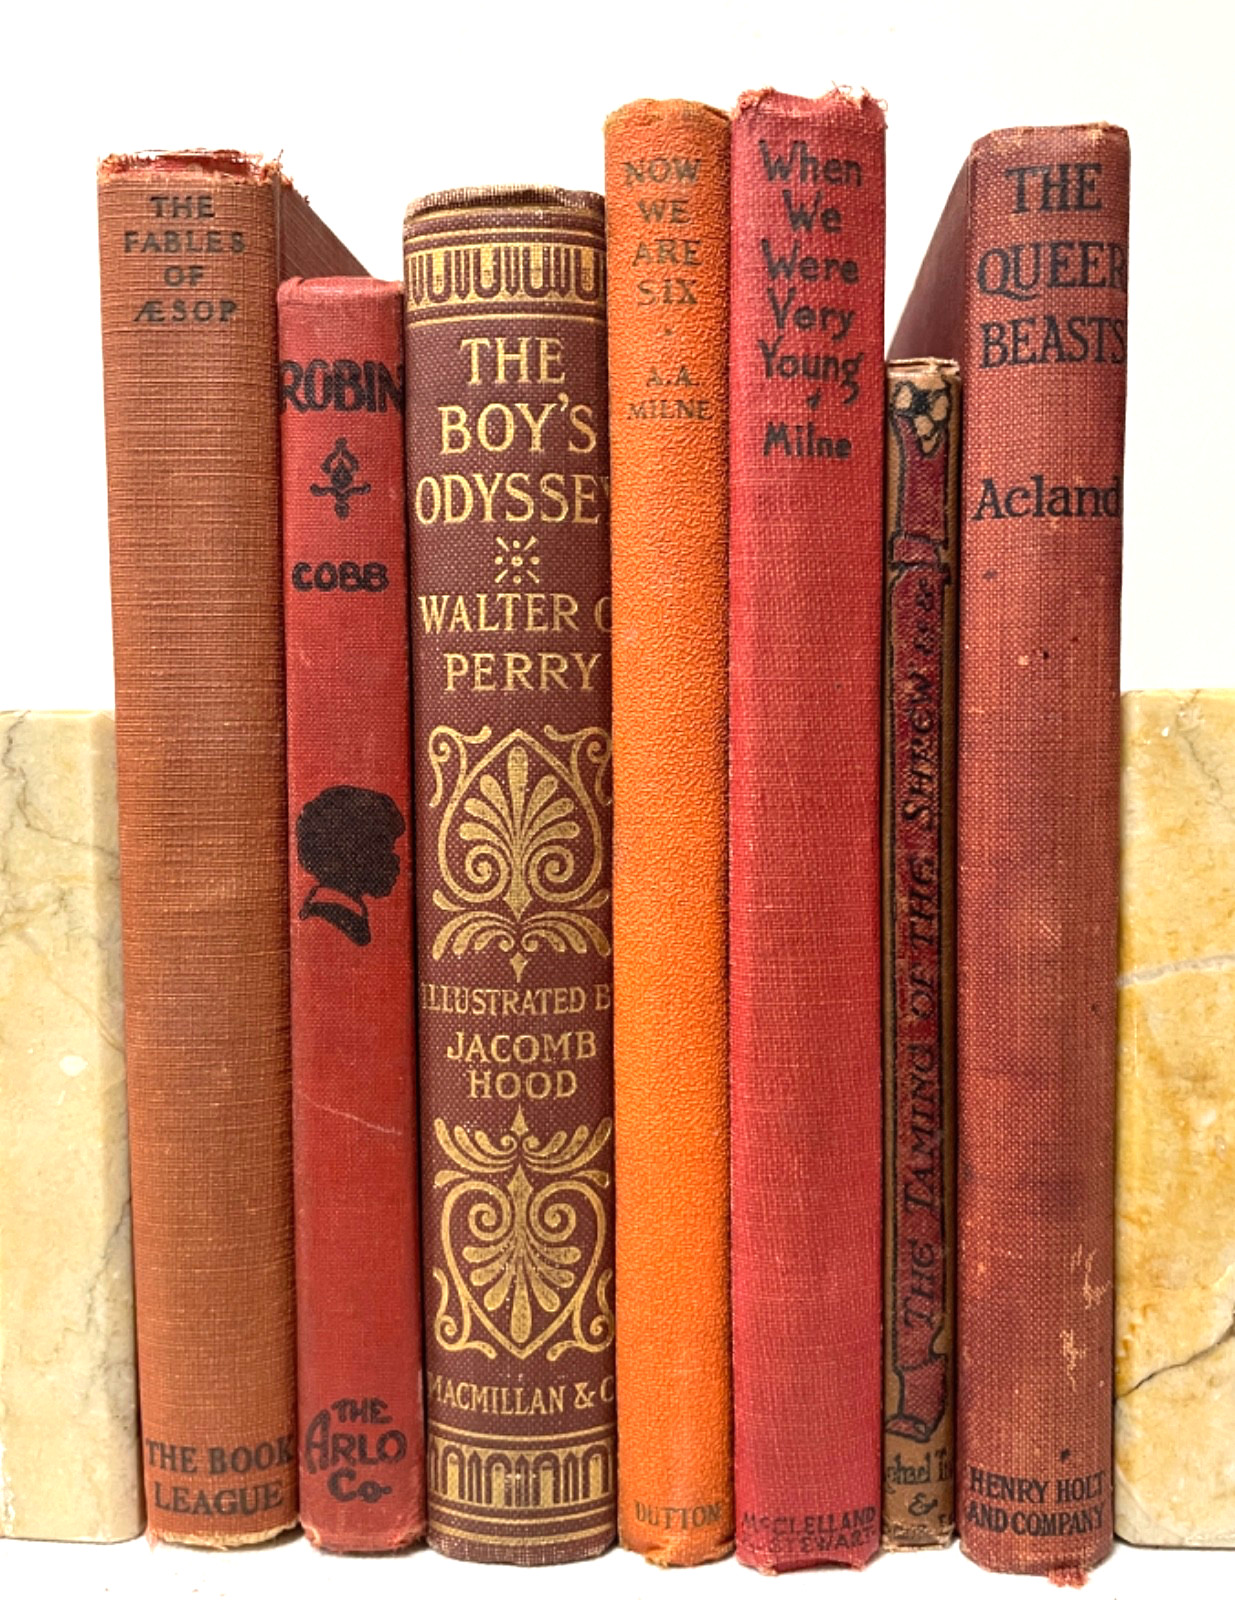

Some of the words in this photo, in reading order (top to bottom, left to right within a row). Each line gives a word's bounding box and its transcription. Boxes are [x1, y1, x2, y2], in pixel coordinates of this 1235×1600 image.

[623, 157, 701, 186] NOW
[758, 138, 862, 187] When
[149, 196, 215, 219] THE
[1005, 163, 1103, 214] THE
[638, 199, 691, 224] WE
[782, 189, 842, 233] We
[123, 230, 246, 254] FABLES
[632, 239, 702, 266] ARE
[760, 238, 859, 284] Were
[164, 266, 204, 288] OF
[977, 240, 1126, 301] QUEER
[637, 279, 698, 305] SIX
[133, 301, 238, 323] ÆSOP
[766, 287, 855, 340] Very
[460, 337, 566, 385] THE
[981, 315, 1126, 369] BEASTS
[280, 359, 404, 413] ROBIN
[757, 335, 864, 405] Young
[437, 392, 598, 454] BOY'S
[627, 399, 714, 420] MILNE
[763, 421, 852, 458] Milne
[971, 474, 1122, 520] Acland
[291, 561, 389, 592] COBB
[419, 593, 579, 634] WALTER
[444, 653, 601, 692] PERRY
[902, 666, 935, 831] SHREW
[908, 854, 935, 950] THE
[910, 954, 936, 1021] OF
[447, 1031, 597, 1063] JACOMB
[467, 1069, 577, 1099] HOOD
[904, 1042, 936, 1215] TAMING
[903, 1237, 935, 1328] THE
[331, 1397, 392, 1424] THE
[573, 1382, 597, 1409] &
[146, 1438, 199, 1474] THE
[208, 1433, 294, 1475] BOOK
[305, 1409, 407, 1474] ARLO
[154, 1479, 284, 1516] LEAGUE
[908, 1492, 938, 1516] &
[970, 1466, 1050, 1504] HENRY
[1056, 1471, 1106, 1504] HOLT
[633, 1502, 722, 1530] DUTTON
[967, 1500, 1009, 1533] AND
[1010, 1504, 1105, 1536] COMPANY
